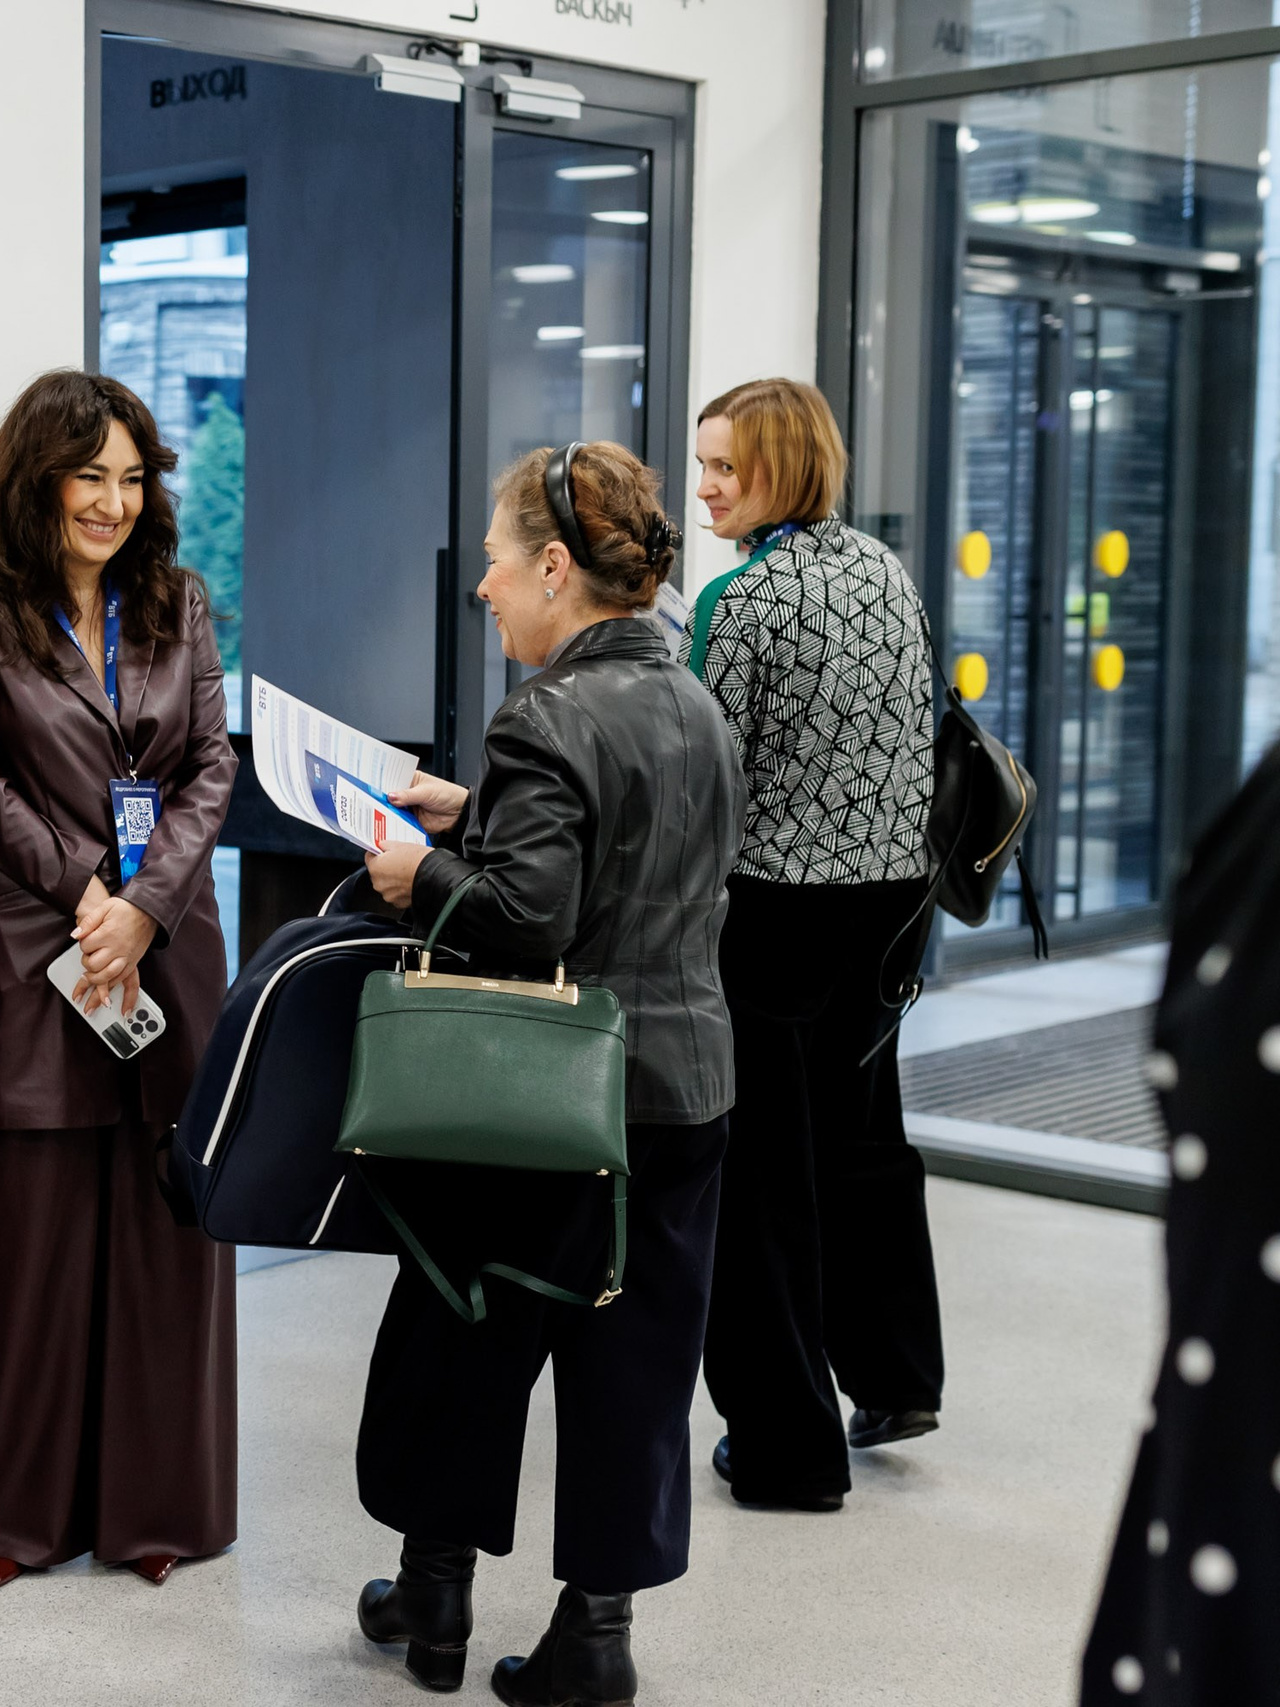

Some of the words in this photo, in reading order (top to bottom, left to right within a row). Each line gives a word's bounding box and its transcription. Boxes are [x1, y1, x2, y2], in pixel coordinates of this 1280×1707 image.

[150, 65, 248, 108] ВЫХОД
[108, 605, 116, 618] ВТБ
[106, 651, 114, 665] ВТБ
[258, 685, 267, 710] ВТБ
